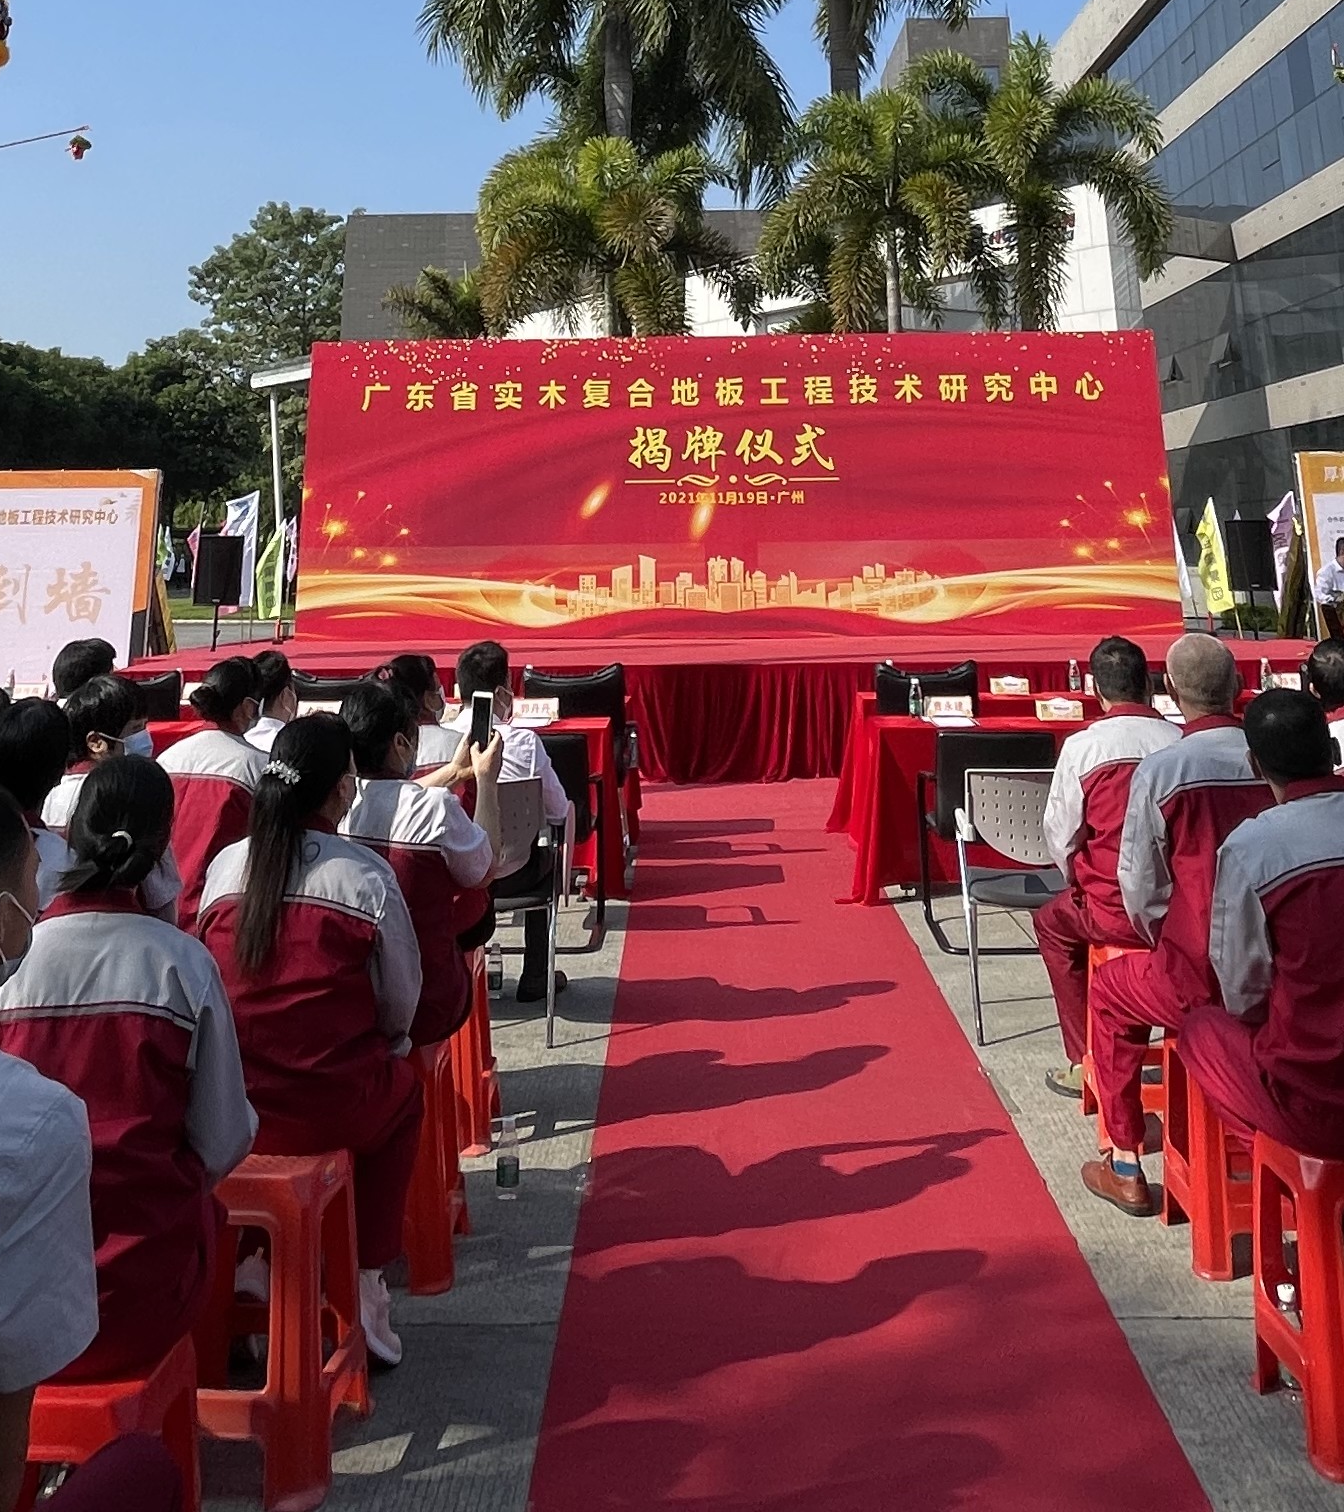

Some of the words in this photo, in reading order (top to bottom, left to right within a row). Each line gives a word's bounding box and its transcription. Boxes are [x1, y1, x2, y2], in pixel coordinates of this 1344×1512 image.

[361, 372, 1107, 411] 广东省实木复合地板工程技术研究中心
[627, 423, 836, 473] 揭牌仪式
